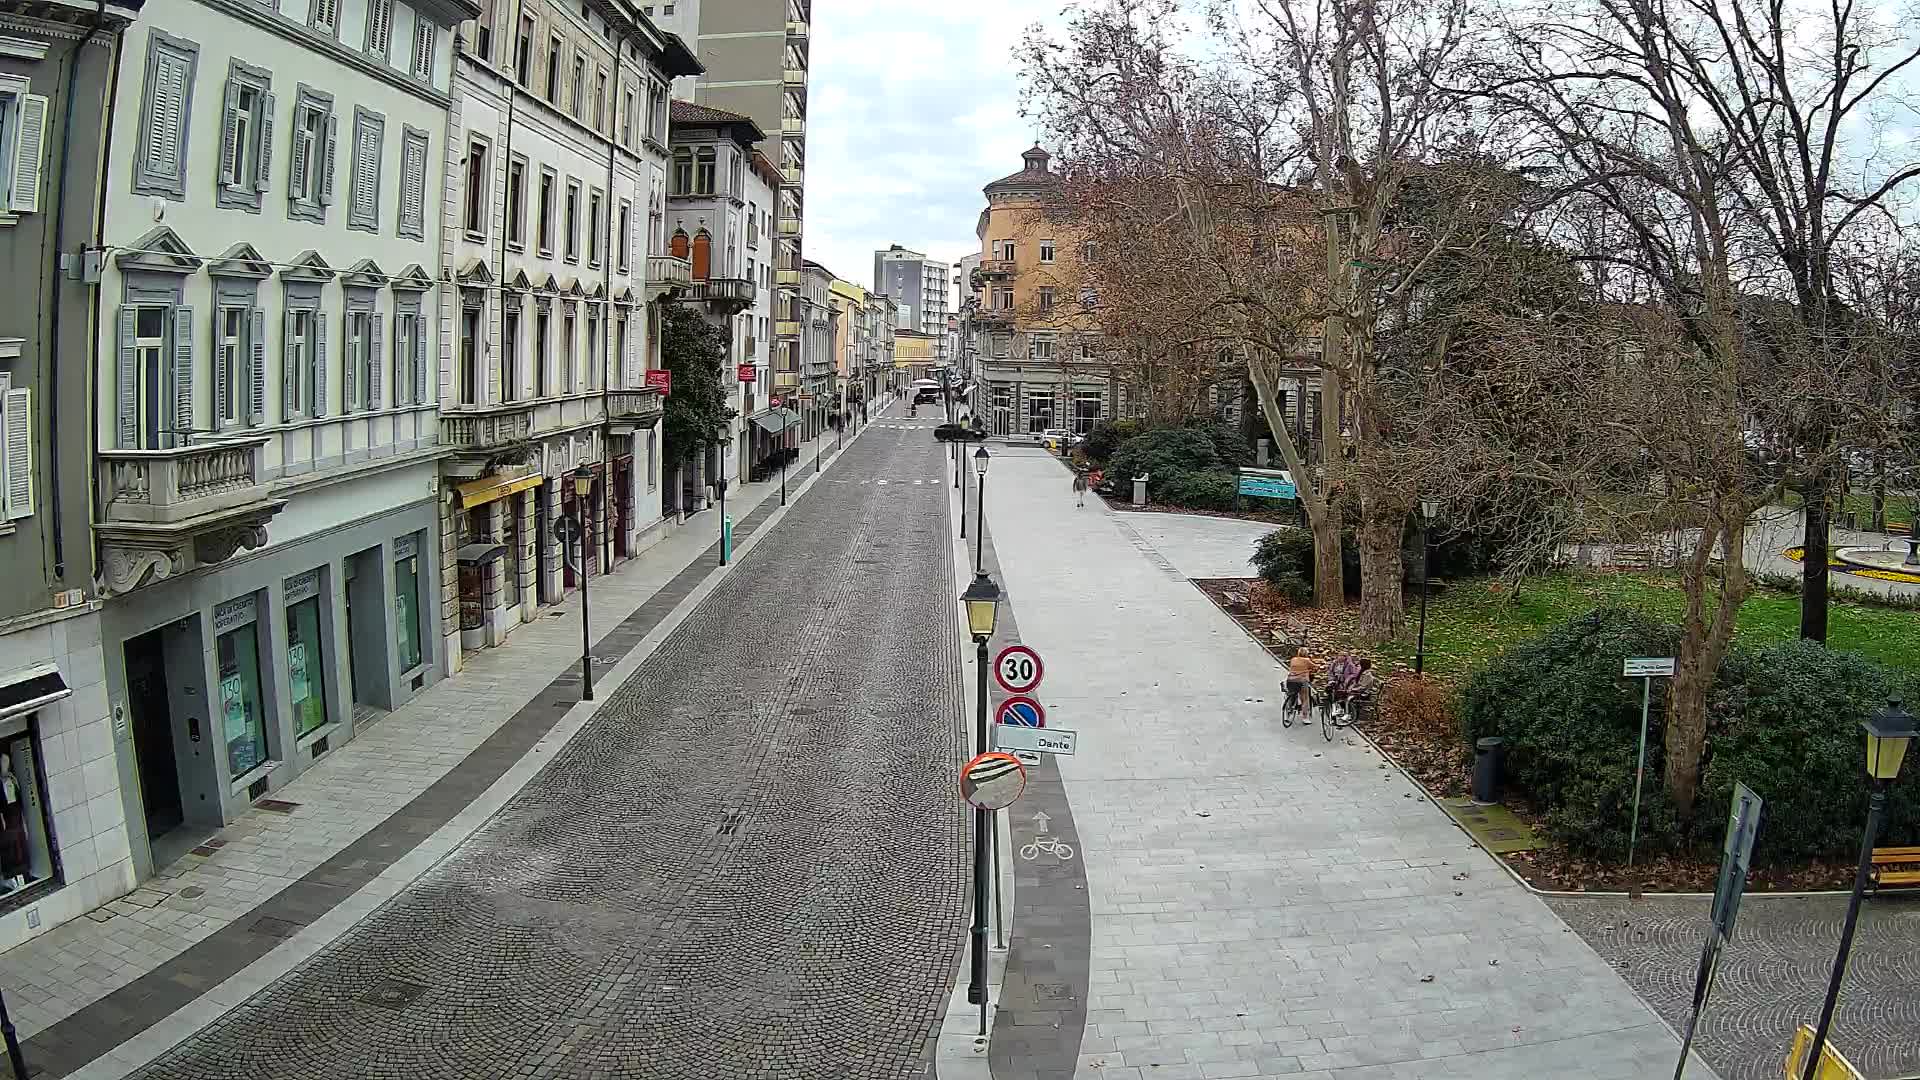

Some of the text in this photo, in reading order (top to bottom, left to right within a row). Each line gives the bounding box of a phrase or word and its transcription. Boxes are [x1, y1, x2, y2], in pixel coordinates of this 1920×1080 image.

[1005, 658, 1033, 681] 30
[222, 678, 240, 700] 130
[1038, 738, 1070, 749] Dante
